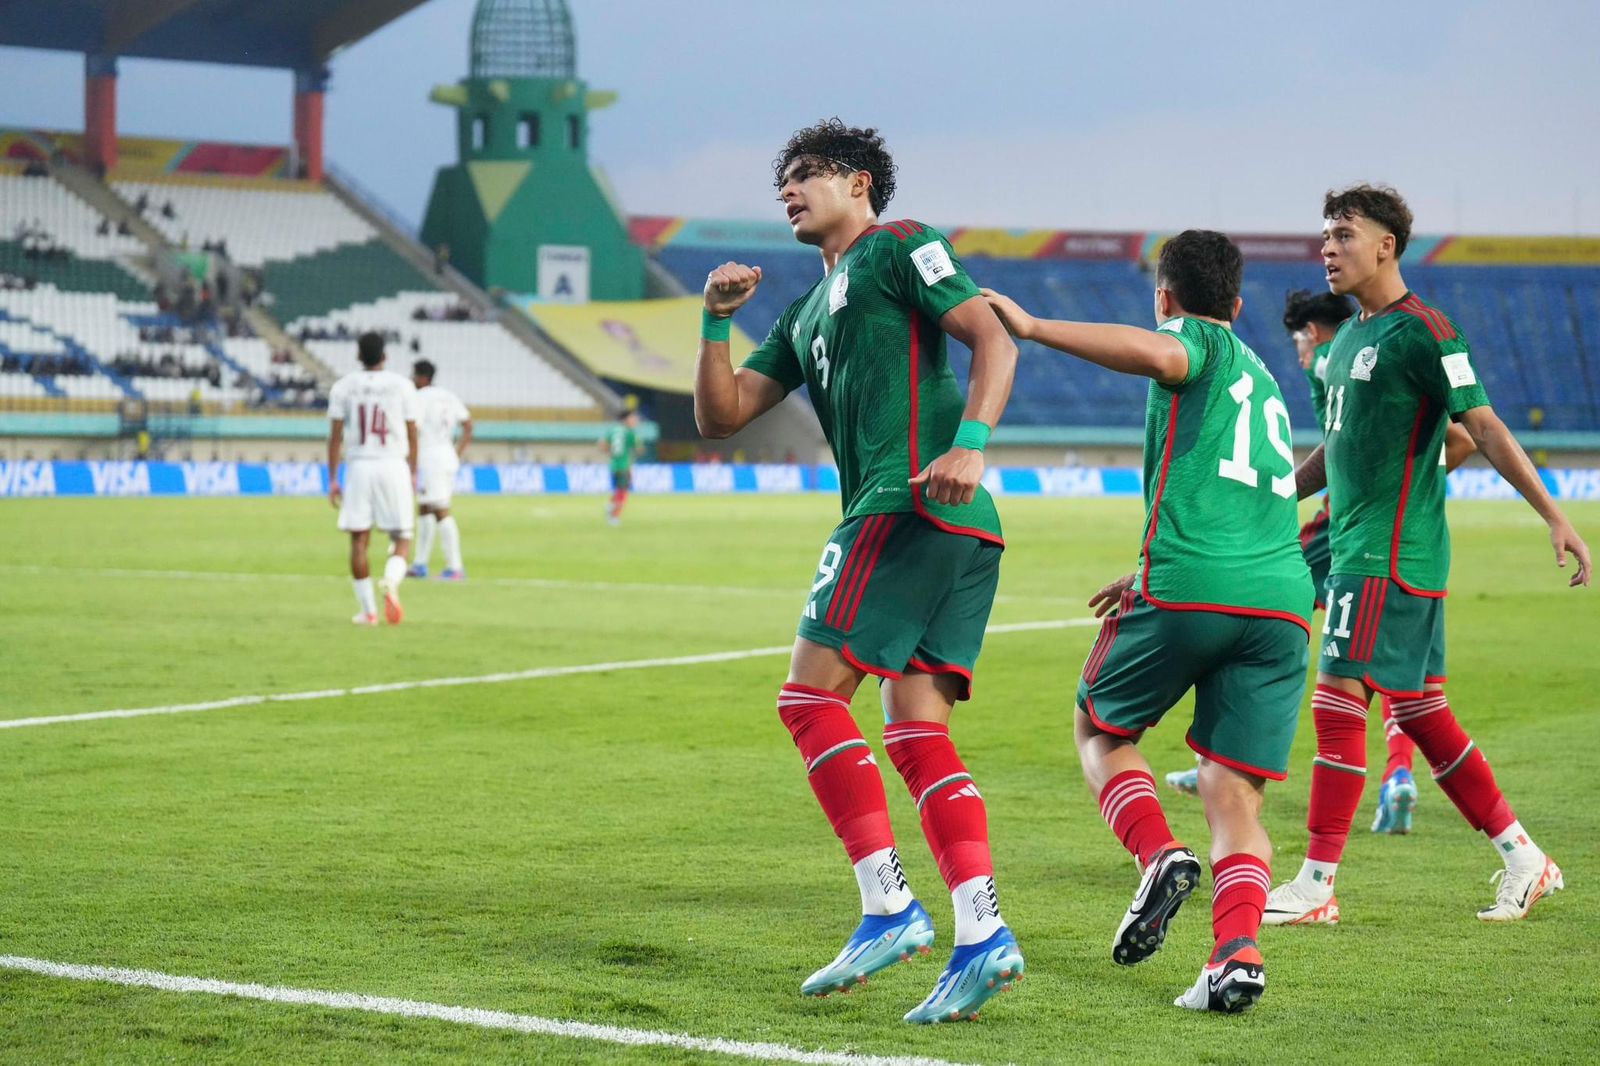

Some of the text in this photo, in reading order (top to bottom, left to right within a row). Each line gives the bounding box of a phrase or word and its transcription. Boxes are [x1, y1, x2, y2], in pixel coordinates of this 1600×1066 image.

[358, 403, 389, 445] 14
[1325, 385, 1345, 432] 11
[1218, 370, 1297, 499] 19
[0, 462, 54, 494] VISA
[91, 462, 151, 495] VISA
[185, 463, 238, 494] VISA
[270, 464, 321, 493] VISA
[812, 541, 842, 593] 9
[1322, 589, 1354, 638] 11
